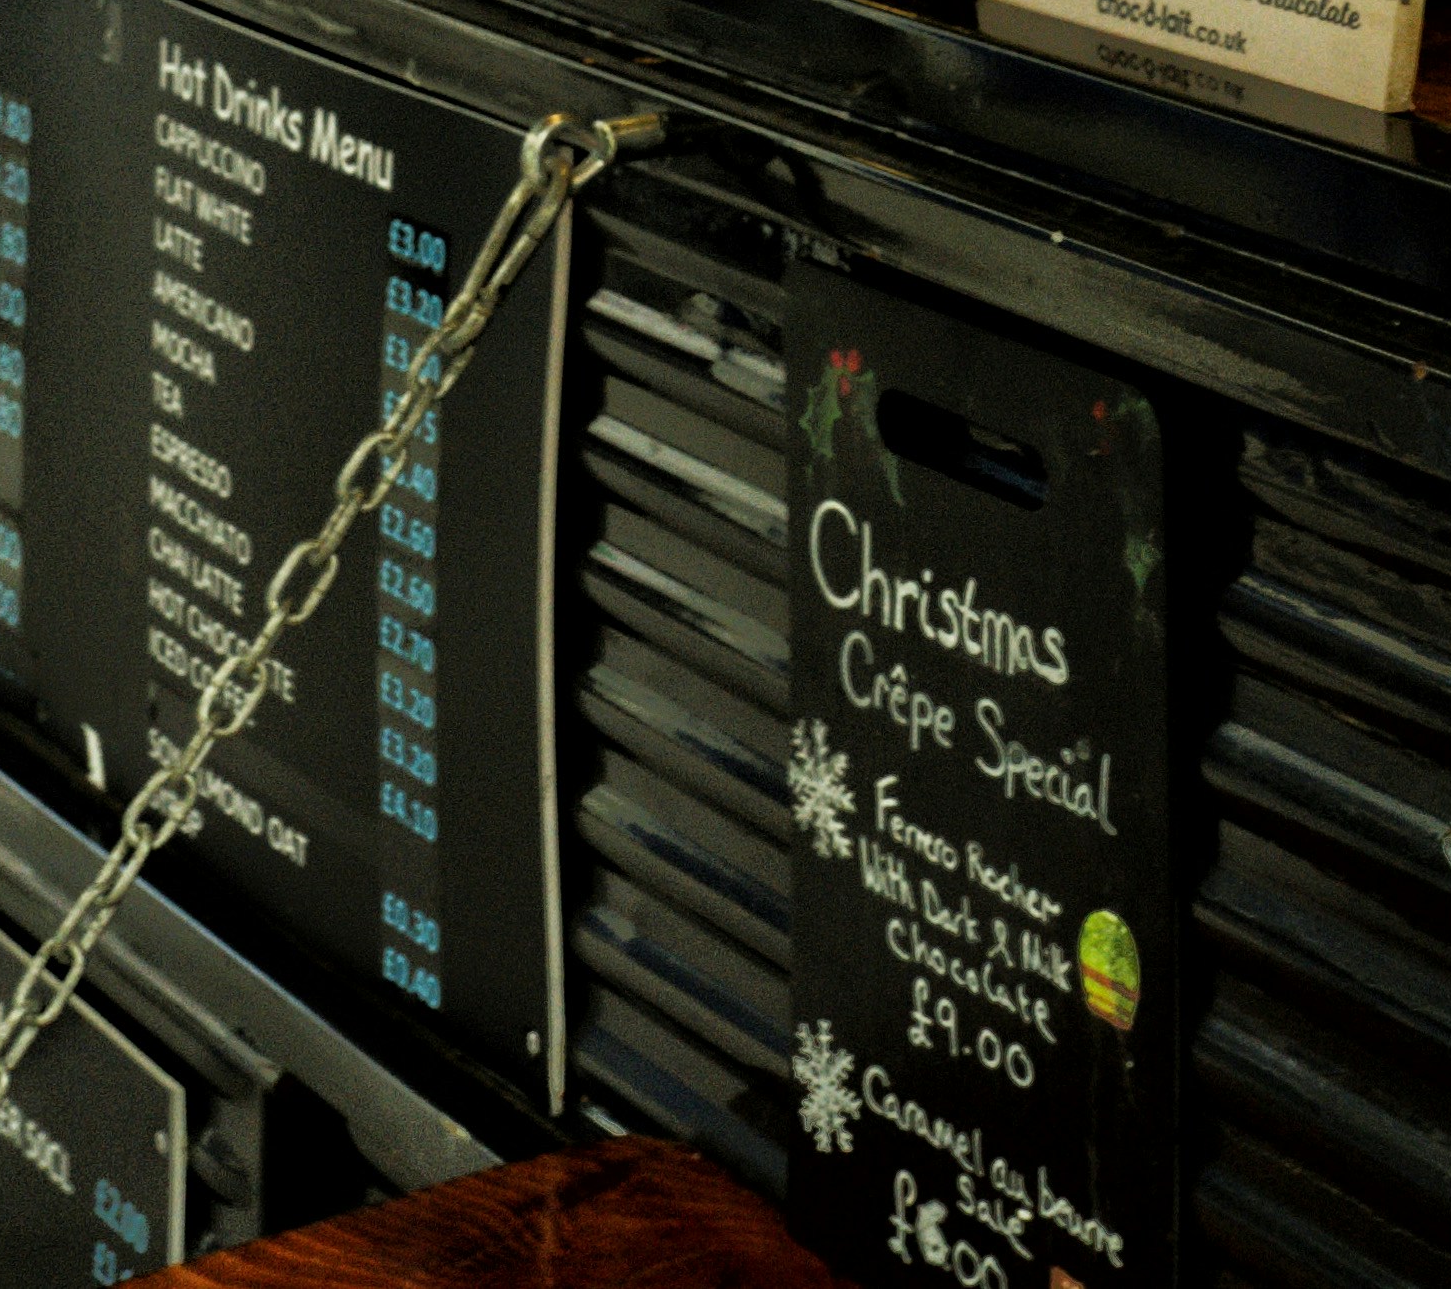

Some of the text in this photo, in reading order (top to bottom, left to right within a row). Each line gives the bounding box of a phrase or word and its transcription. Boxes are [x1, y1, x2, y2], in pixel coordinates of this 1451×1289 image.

[159, 36, 395, 193] Hot Drinks Menu
[809, 499, 1071, 687] Christmas
[839, 630, 1119, 838] Crêpe Special
[964, 838, 1064, 922] Rocher
[885, 916, 1059, 1045] Chocolate
[907, 976, 1036, 1089] £9.00
[861, 1063, 987, 1178] Caramel
